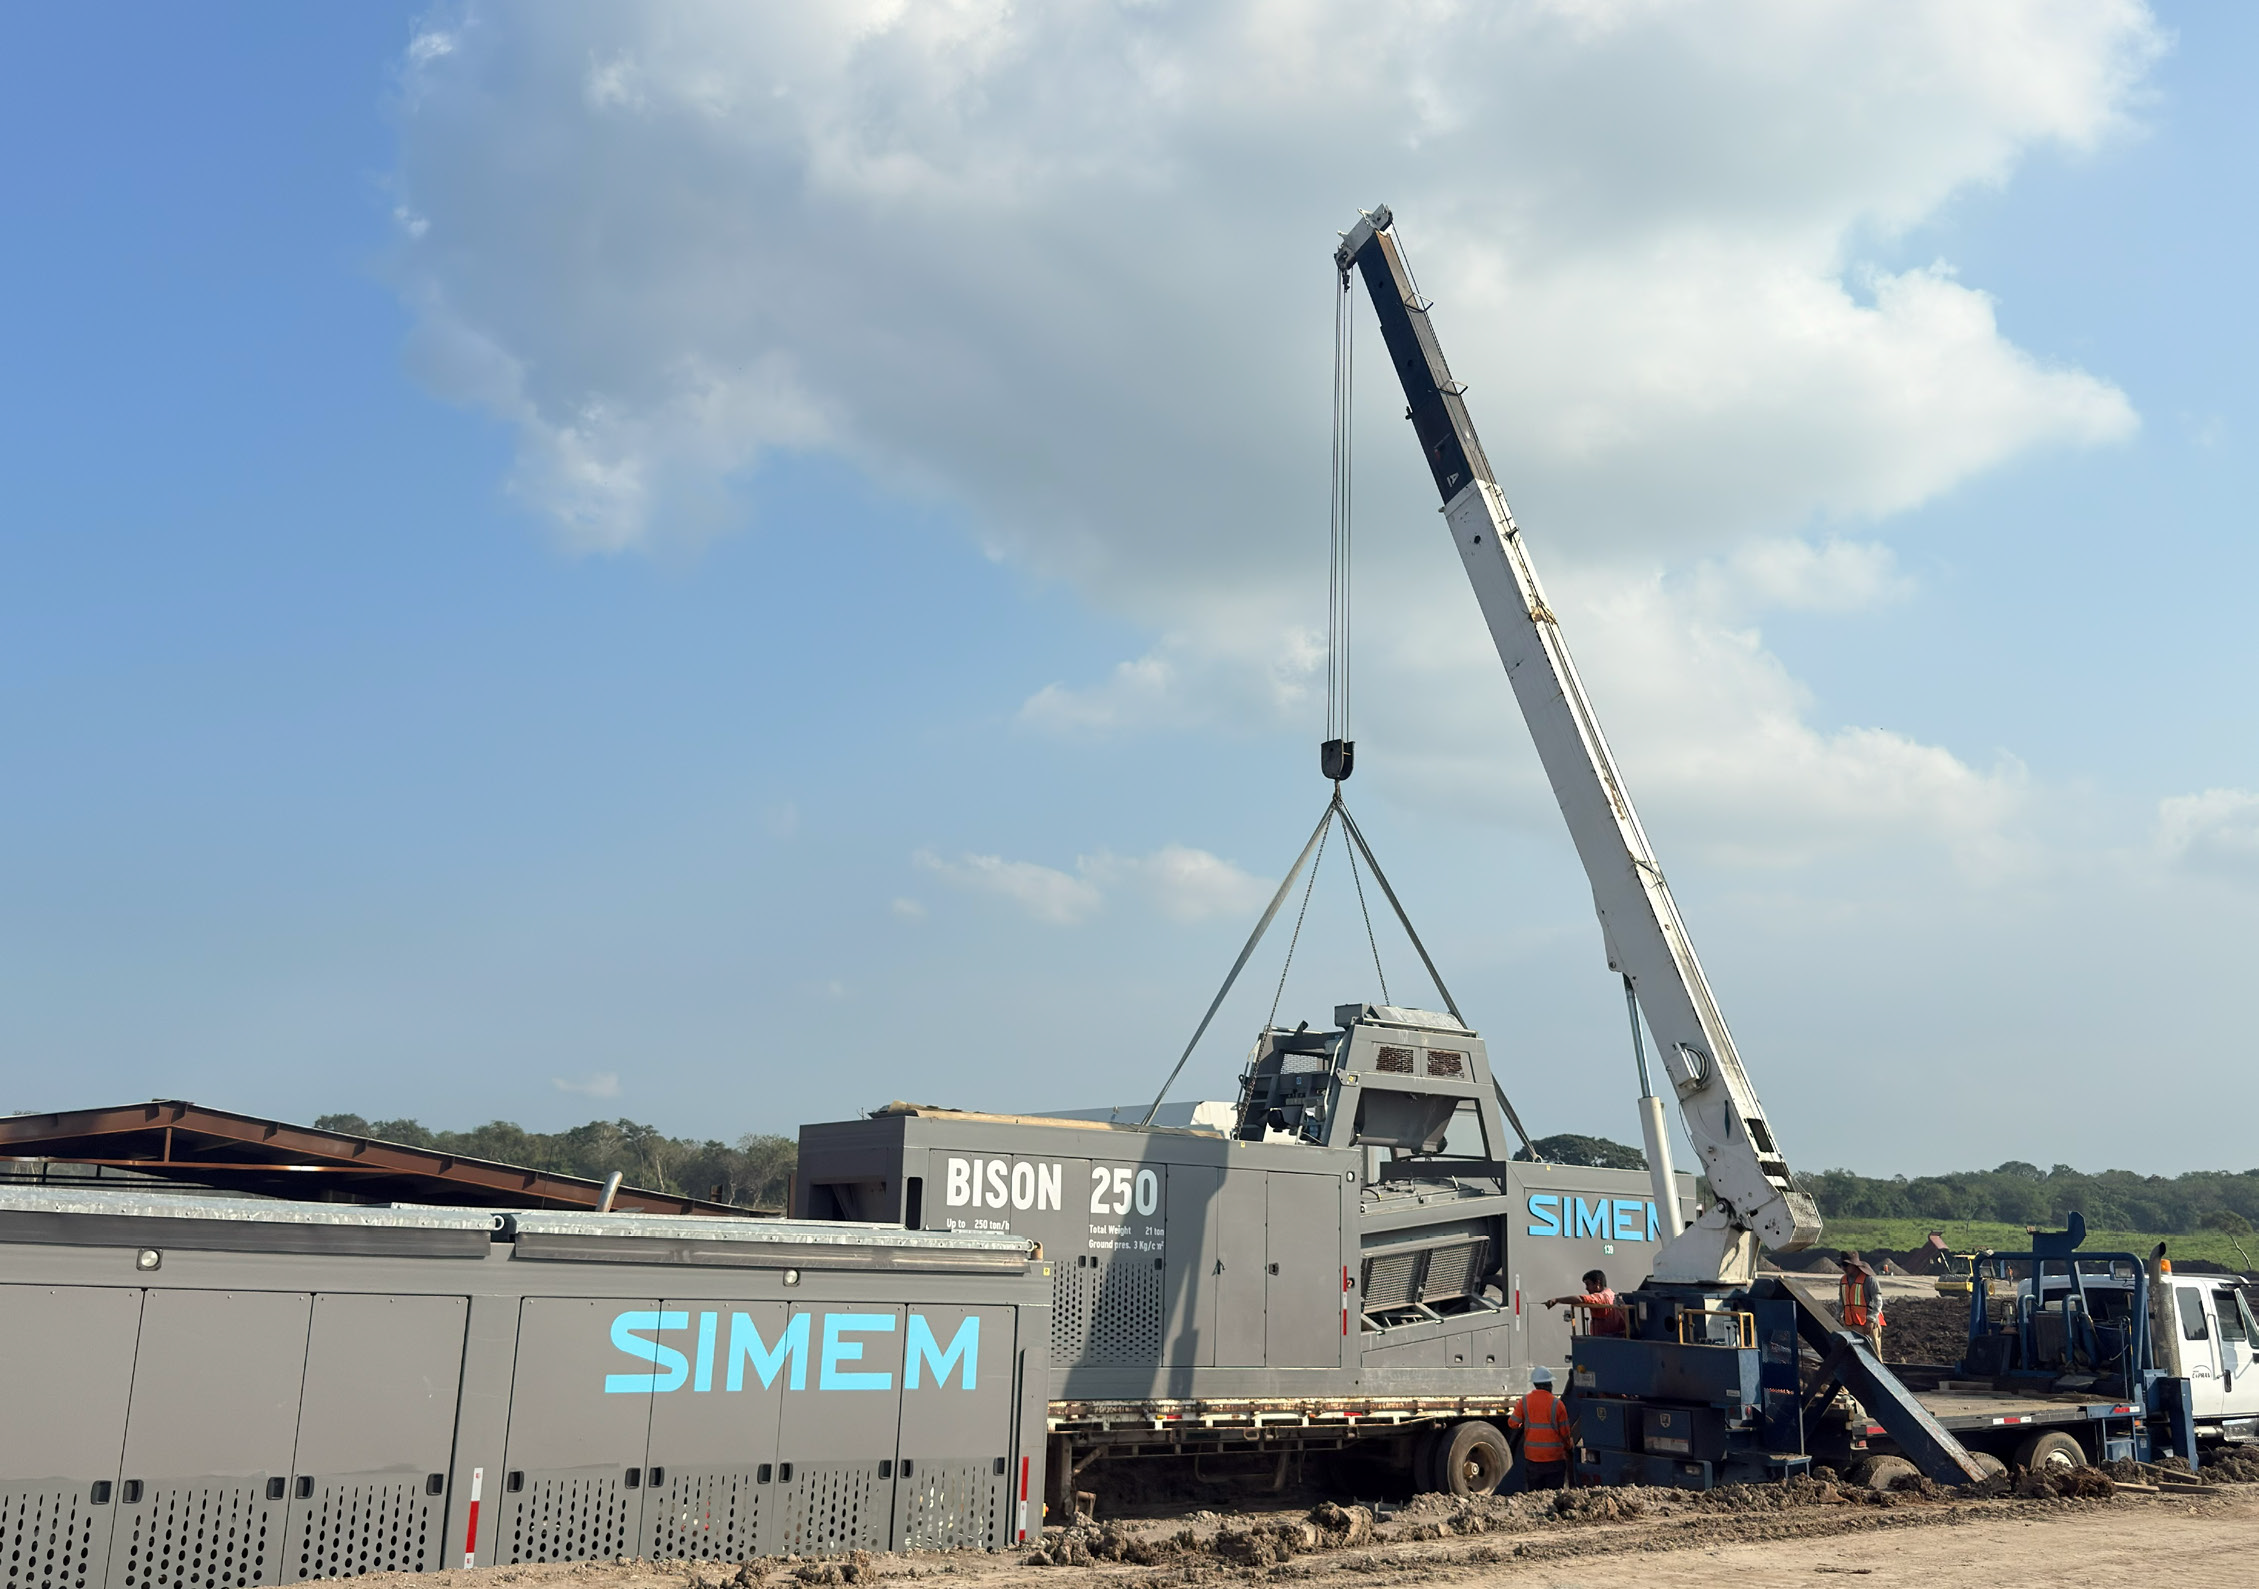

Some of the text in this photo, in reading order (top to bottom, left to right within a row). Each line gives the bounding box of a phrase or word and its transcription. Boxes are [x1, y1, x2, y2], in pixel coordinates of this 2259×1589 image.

[946, 1157, 1158, 1216] BISON 250
[946, 1218, 1010, 1230] Up to 250 ton/h
[1088, 1224, 1165, 1237] Total Weight 21 ton
[1088, 1238, 1114, 1249] Ground
[1114, 1241, 1131, 1251] pres.
[1133, 1240, 1138, 1250] 3
[604, 1311, 980, 1393] SIMEM
